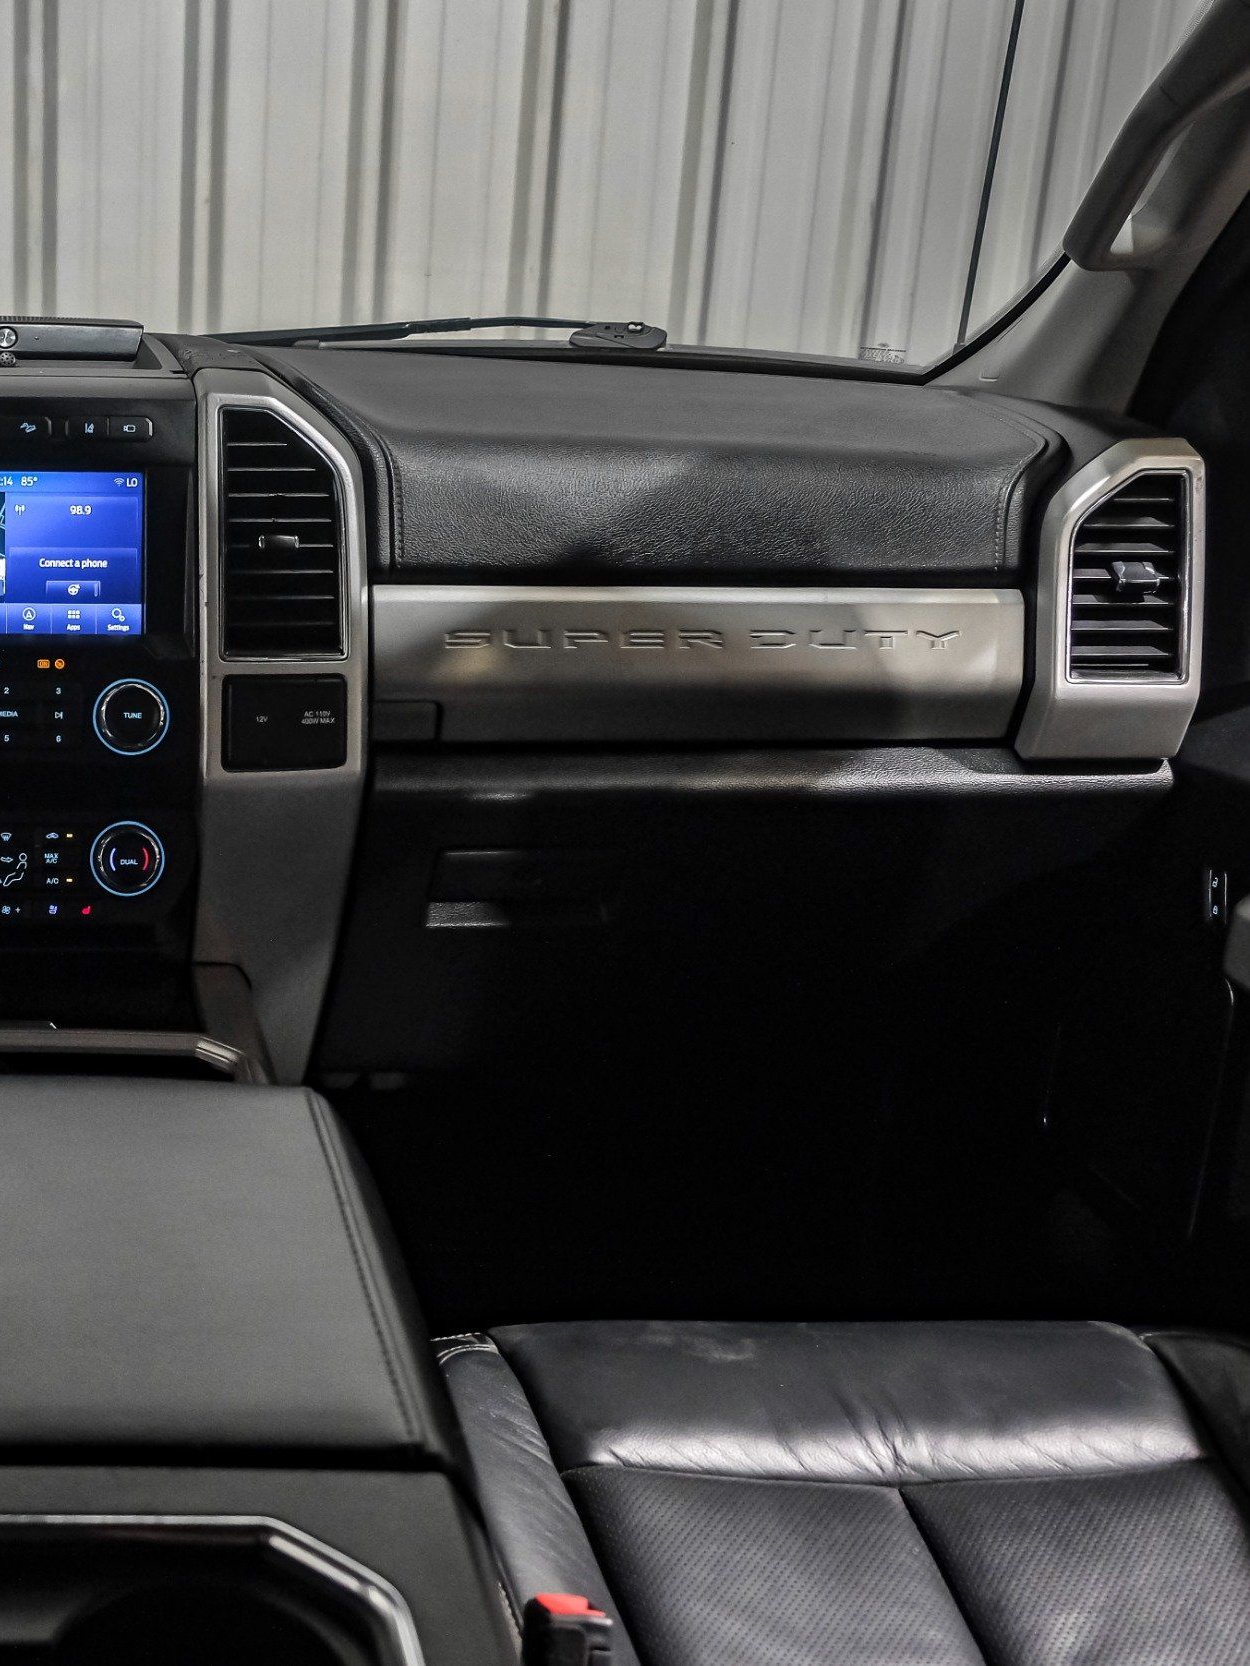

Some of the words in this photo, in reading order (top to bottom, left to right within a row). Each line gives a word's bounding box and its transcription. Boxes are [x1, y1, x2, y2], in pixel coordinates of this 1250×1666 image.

[126, 477, 138, 487] LO
[70, 505, 91, 516] 98.9
[39, 558, 74, 568] Connect
[76, 560, 81, 568] a
[81, 558, 107, 570] phone
[107, 624, 130, 632] Settings
[444, 629, 725, 650] SUPER
[749, 629, 961, 650] DUTY
